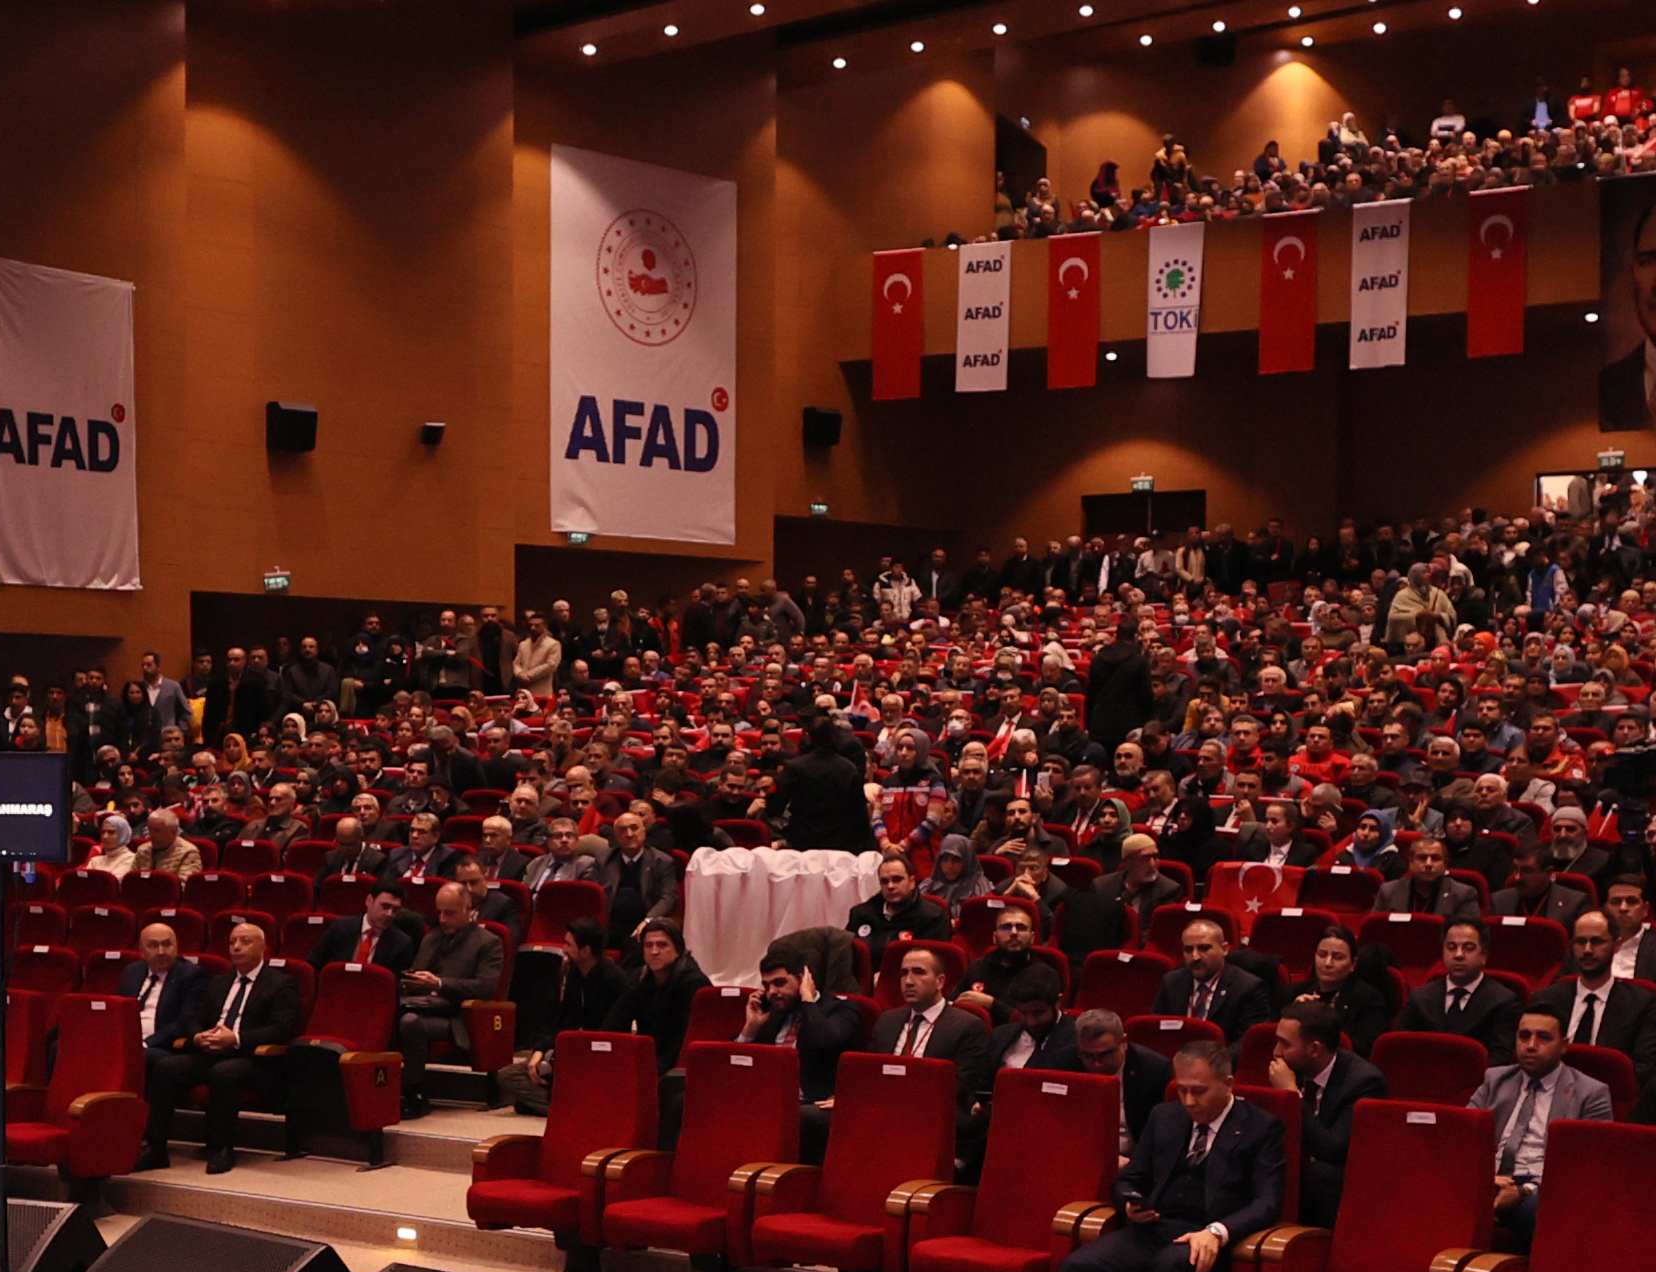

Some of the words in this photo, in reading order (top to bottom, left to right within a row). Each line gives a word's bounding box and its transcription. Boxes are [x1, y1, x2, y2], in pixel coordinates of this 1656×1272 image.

[1360, 224, 1400, 242] AFAD
[965, 260, 1002, 274] AFAD
[1359, 274, 1399, 292] AFAD
[964, 306, 1002, 321] AFAD
[1358, 326, 1397, 342] AFAD
[962, 353, 1000, 368] AFAD
[565, 395, 720, 473] AFAD
[376, 1068, 387, 1085] A
